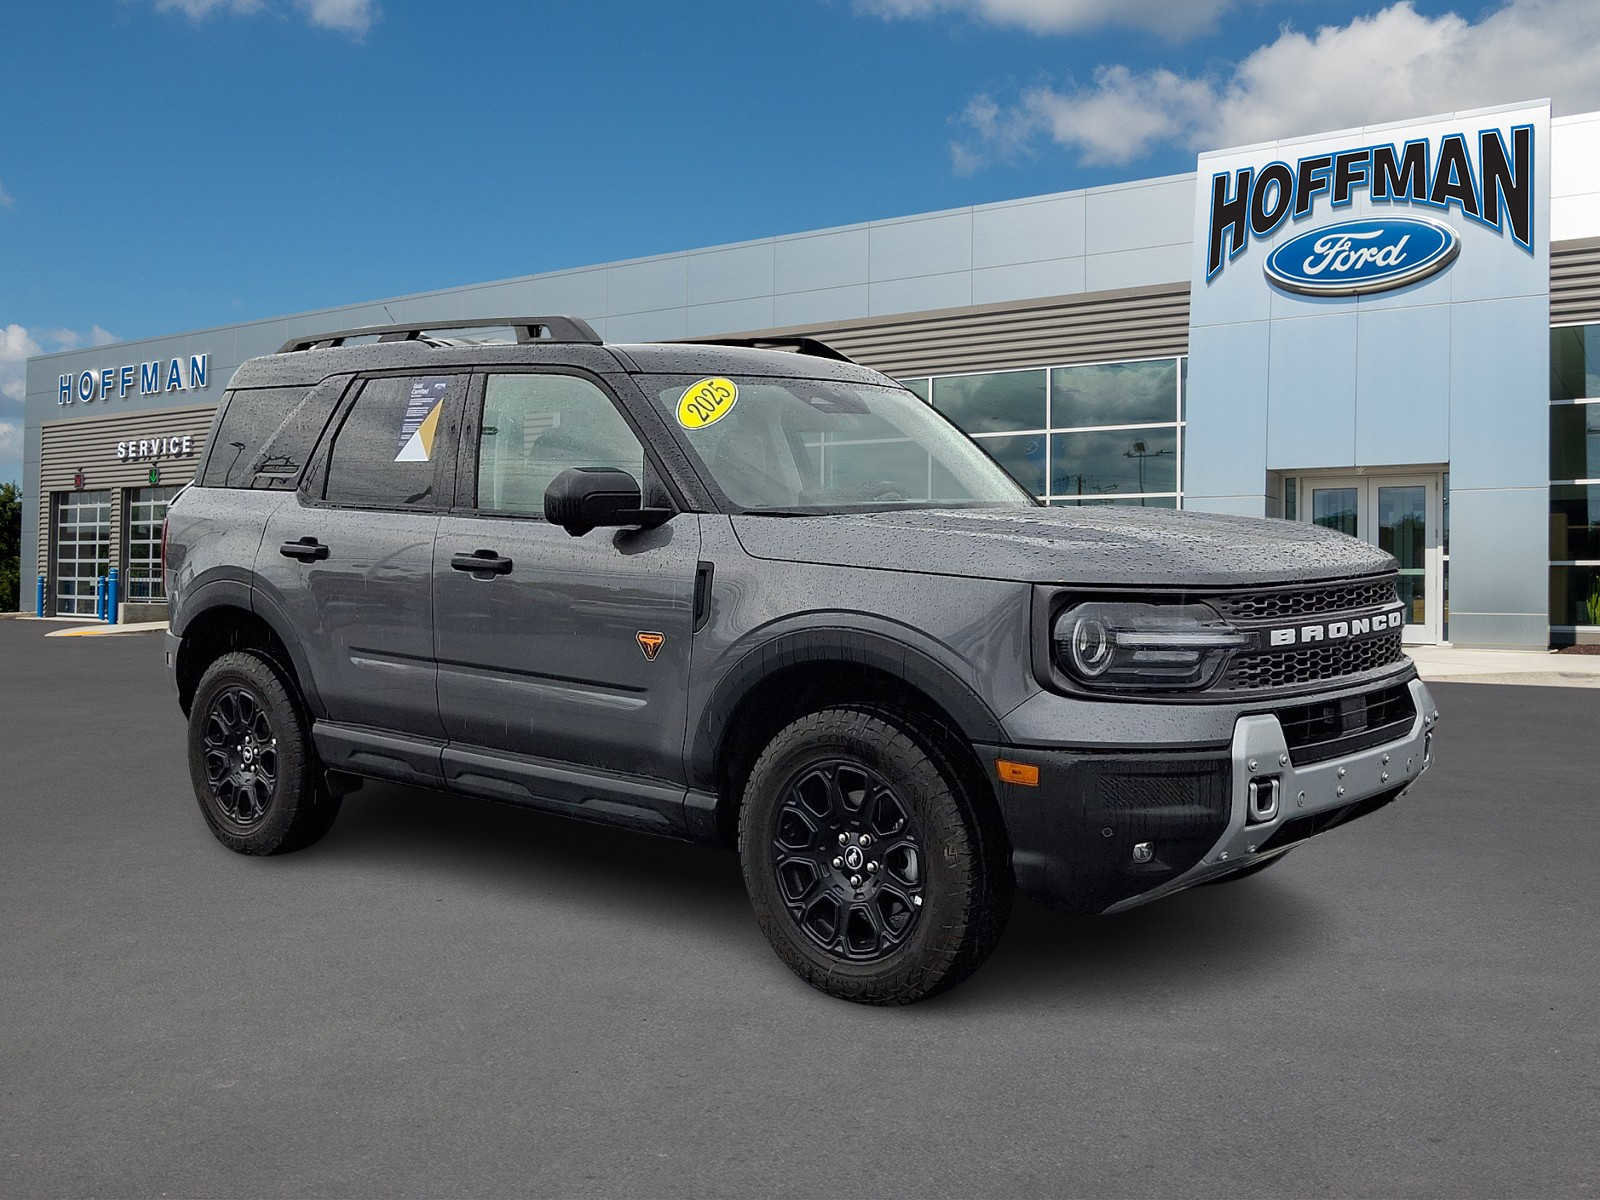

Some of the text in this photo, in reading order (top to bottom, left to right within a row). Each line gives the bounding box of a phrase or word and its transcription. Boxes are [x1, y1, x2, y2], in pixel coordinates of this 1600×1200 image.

[1206, 124, 1534, 283] HOFFMAN
[1302, 229, 1411, 276] Ford
[58, 354, 208, 405] HOFFMAN
[687, 381, 730, 422] 2025
[117, 436, 192, 458] SERVICE
[1270, 612, 1401, 646] BRONCO
